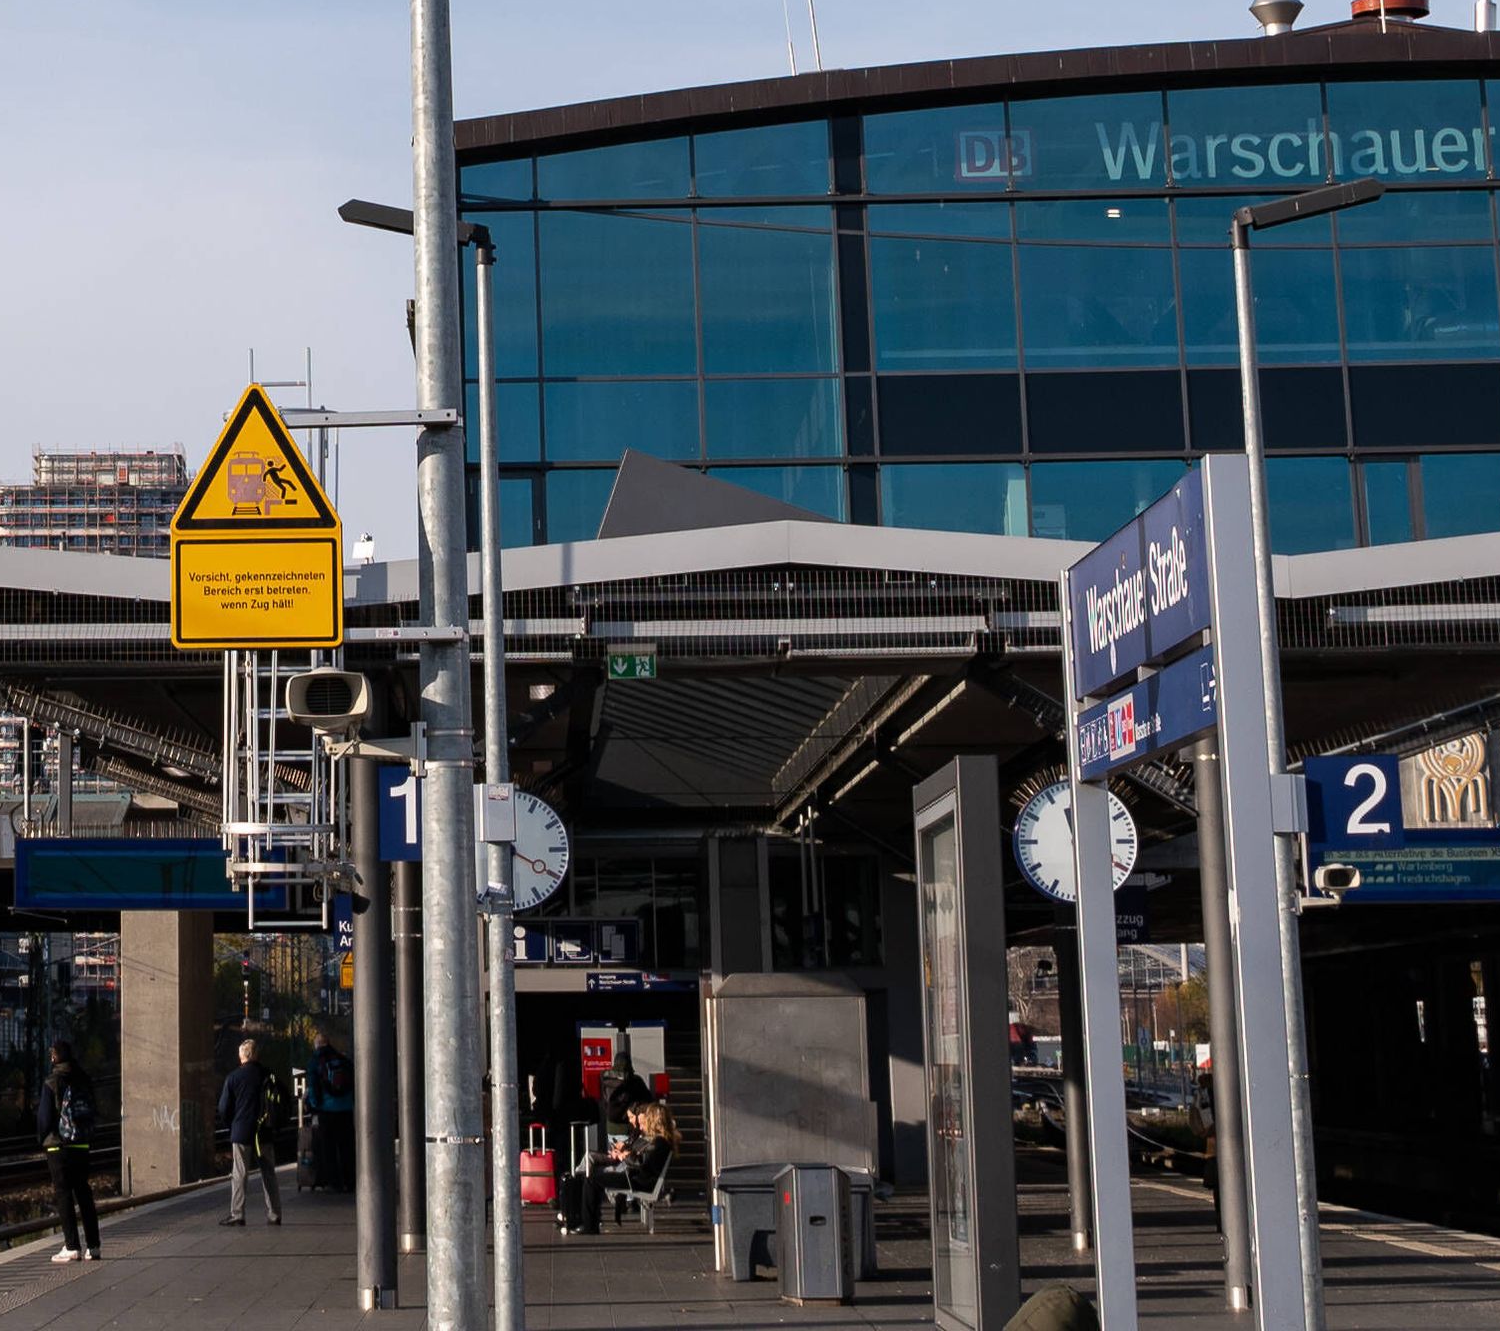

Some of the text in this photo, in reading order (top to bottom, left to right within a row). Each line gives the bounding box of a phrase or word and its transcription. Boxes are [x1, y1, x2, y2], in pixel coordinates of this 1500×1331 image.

[966, 135, 1027, 173] DB
[1095, 117, 1495, 180] Warschauer
[188, 571, 325, 584] Vorsicht, gekennzeichneten
[203, 586, 241, 596] Bereich
[244, 586, 264, 595] erst
[1086, 530, 1188, 654] Warschauer Straße
[220, 599, 294, 611] wenn Zug hält!
[1343, 763, 1391, 834] 2
[389, 775, 417, 844] 1
[1430, 848, 1444, 858] die
[1397, 862, 1453, 873] Wartenberg
[1397, 873, 1471, 885] Friedrichshagen
[294, 1077, 306, 1097] H
